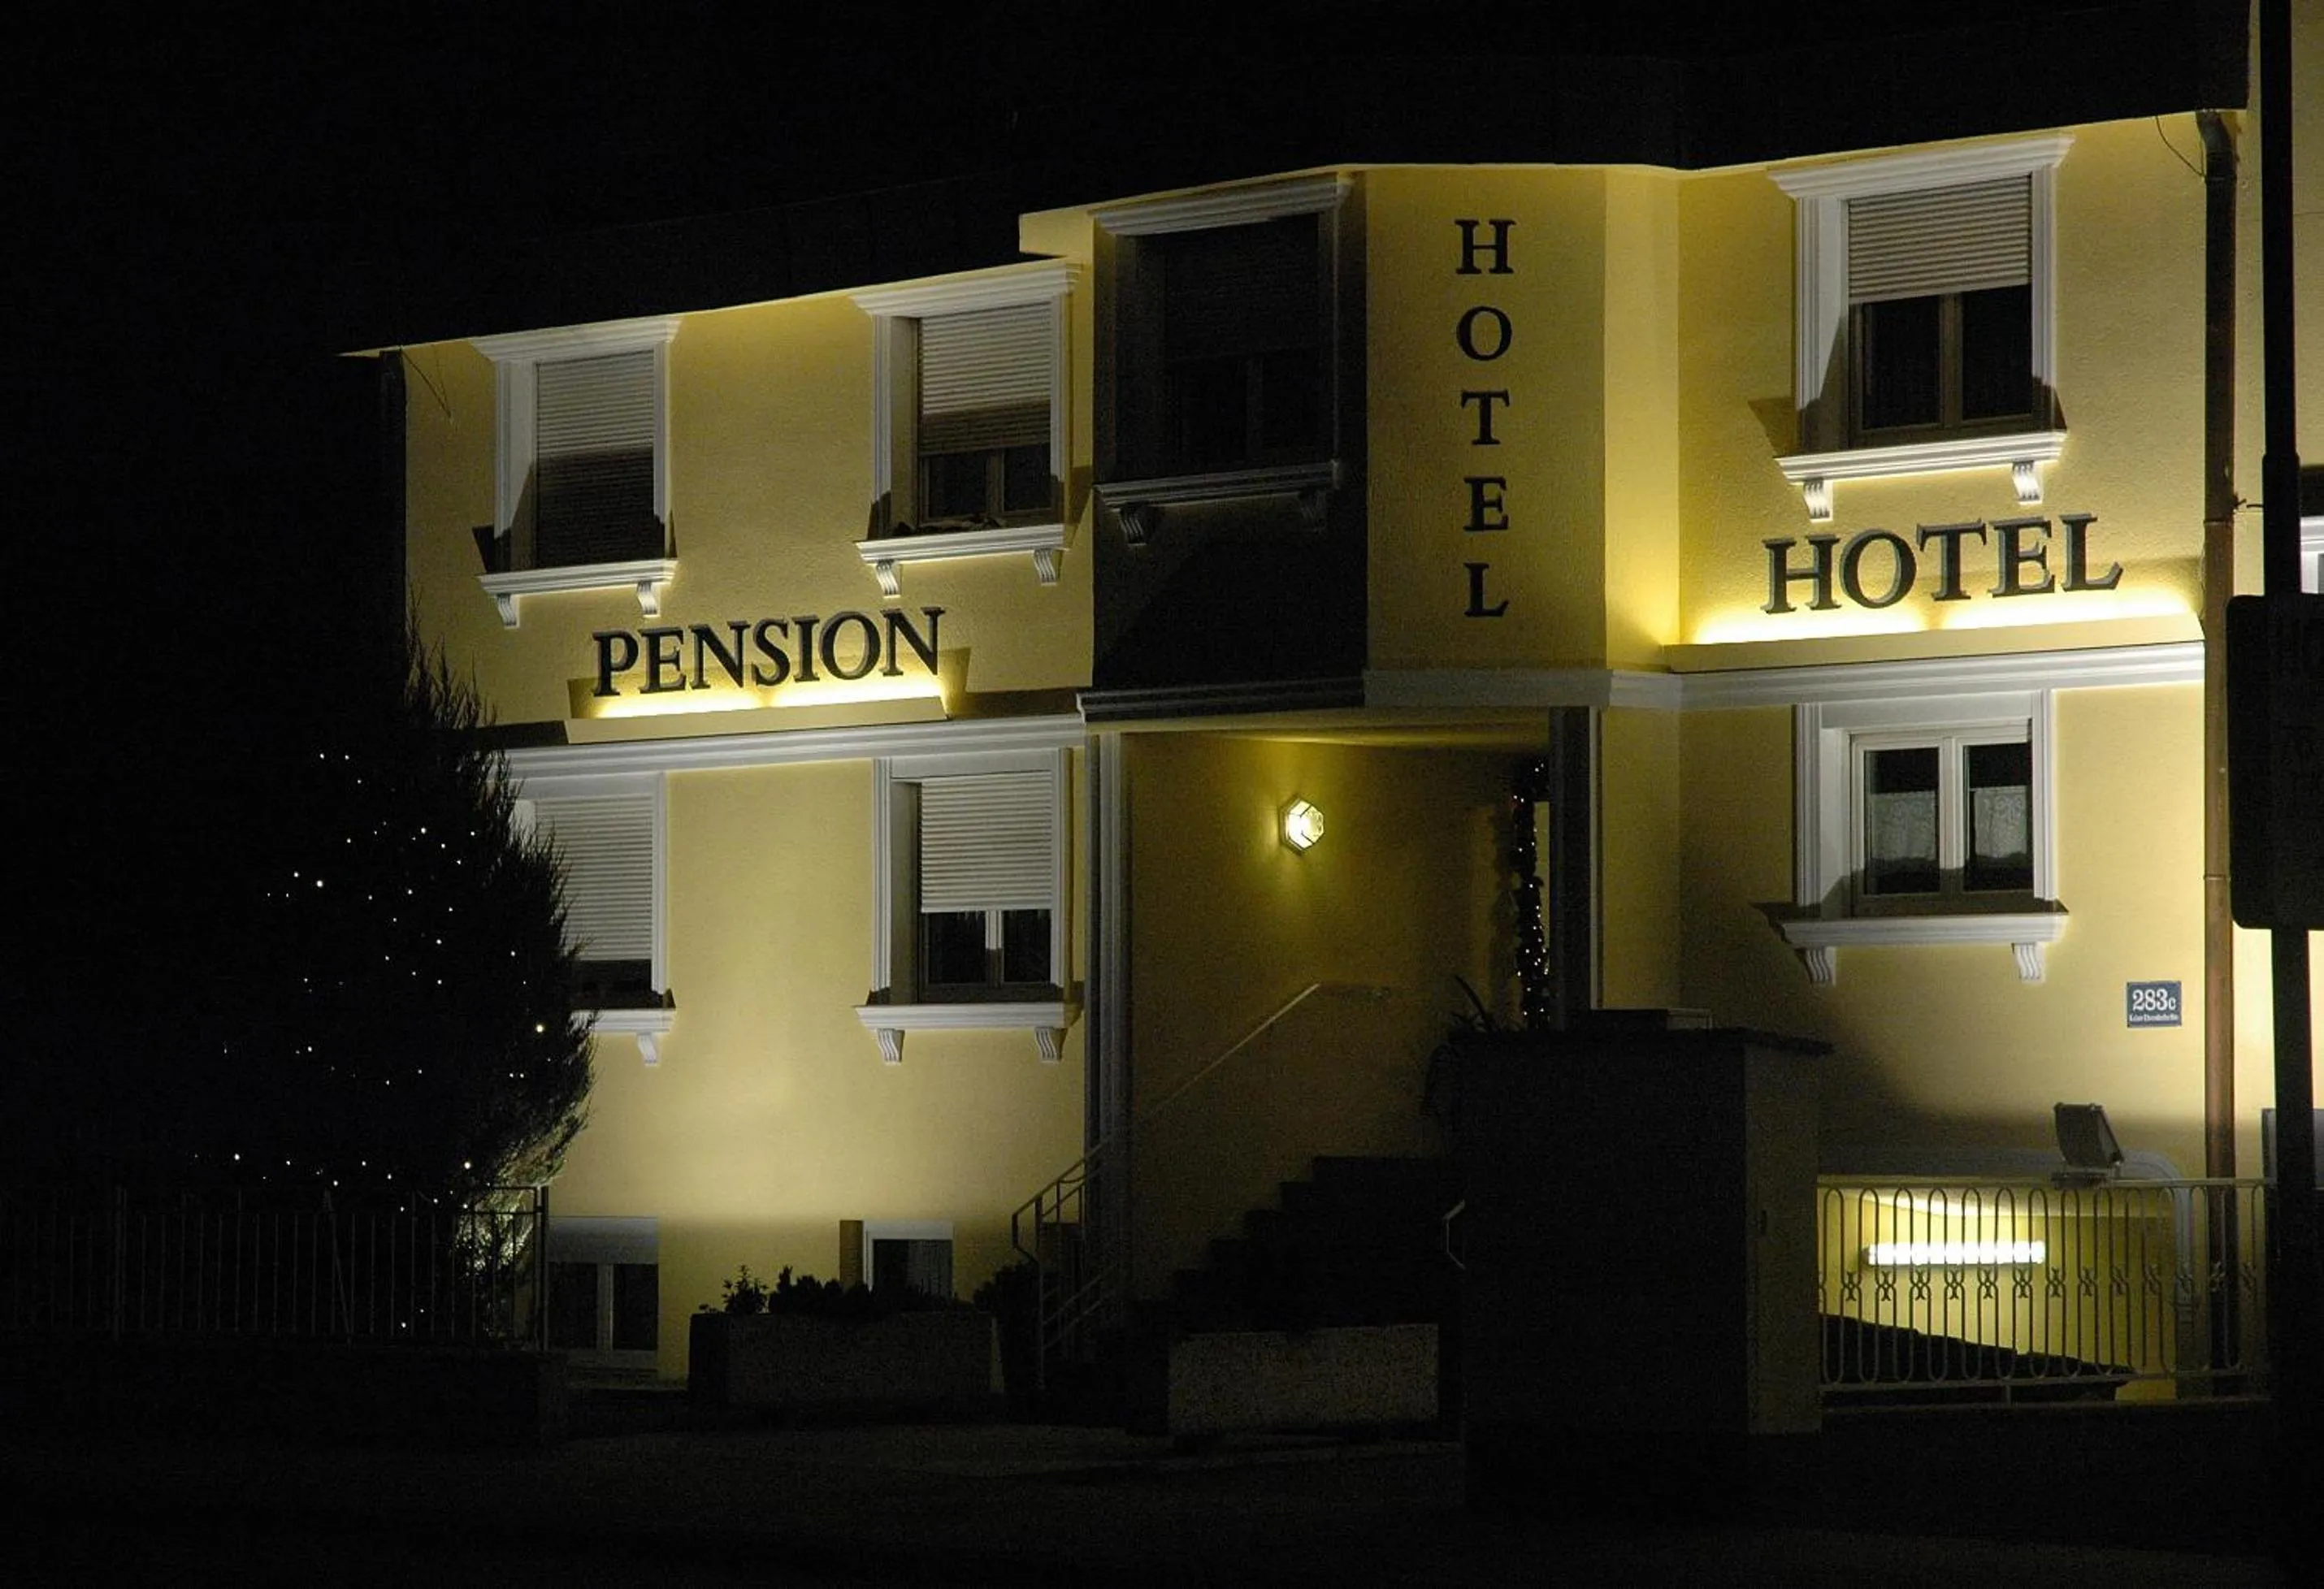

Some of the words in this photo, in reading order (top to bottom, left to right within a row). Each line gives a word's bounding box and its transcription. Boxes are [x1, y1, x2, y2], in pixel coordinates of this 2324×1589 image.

[1455, 219, 1516, 617] HOTEL
[1760, 513, 2123, 614] HOTEL
[592, 606, 946, 697] PENSION
